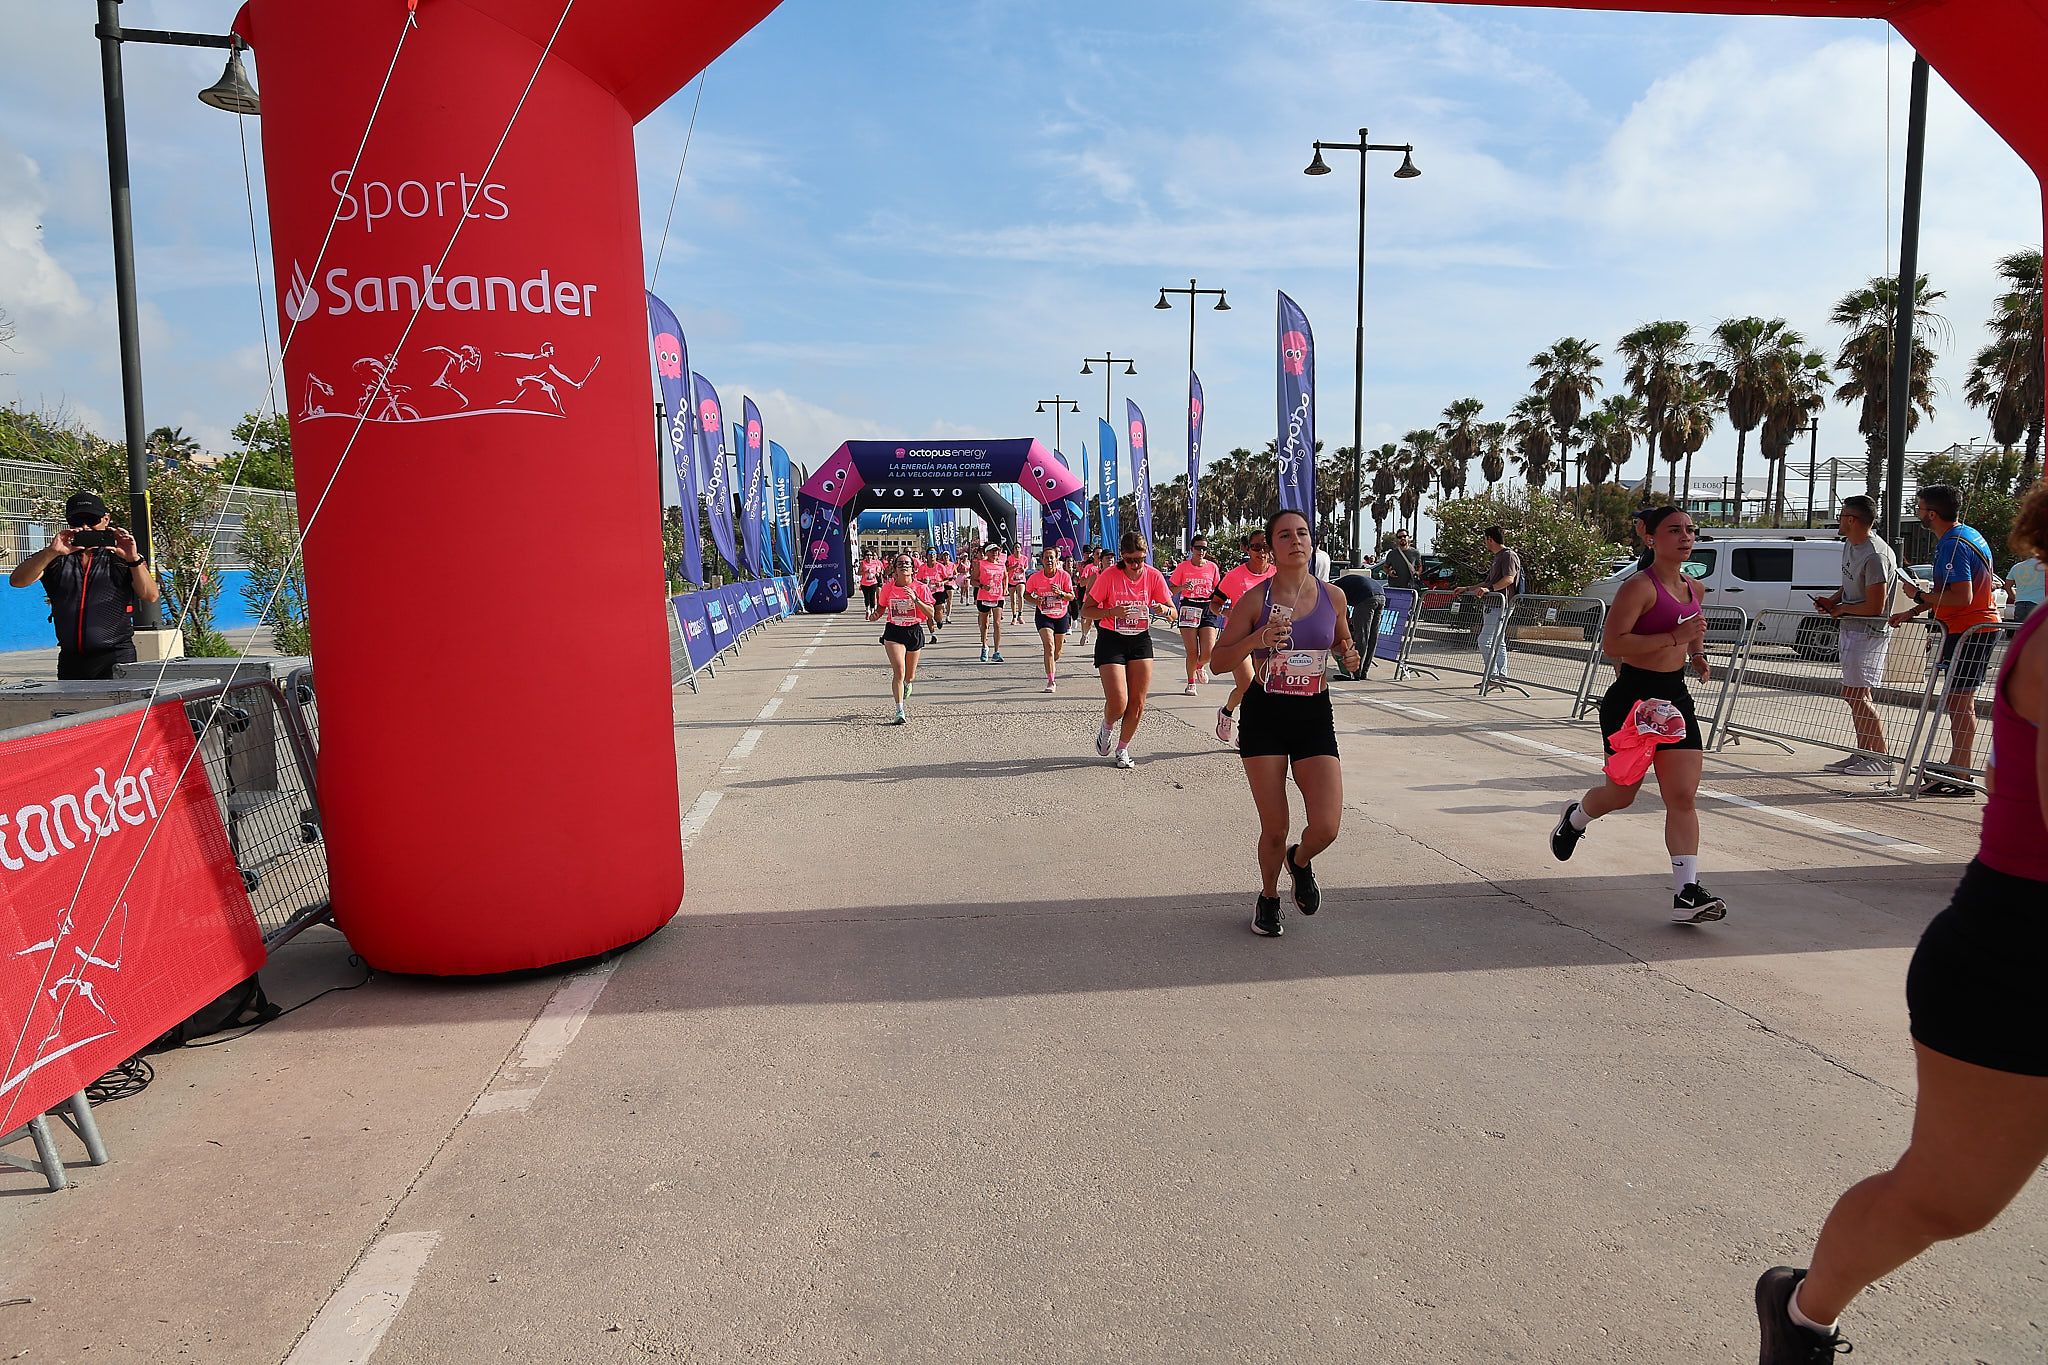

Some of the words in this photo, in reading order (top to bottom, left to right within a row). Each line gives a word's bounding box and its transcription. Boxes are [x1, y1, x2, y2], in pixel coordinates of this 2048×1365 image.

[330, 169, 510, 233] Sports
[325, 264, 598, 317] Santander
[909, 449, 951, 460] octopus
[951, 449, 987, 460] energy
[901, 461, 935, 470] ENERGÍA
[872, 488, 963, 497] VOLVO
[880, 512, 913, 528] Marlene
[1286, 675, 1311, 685] 016
